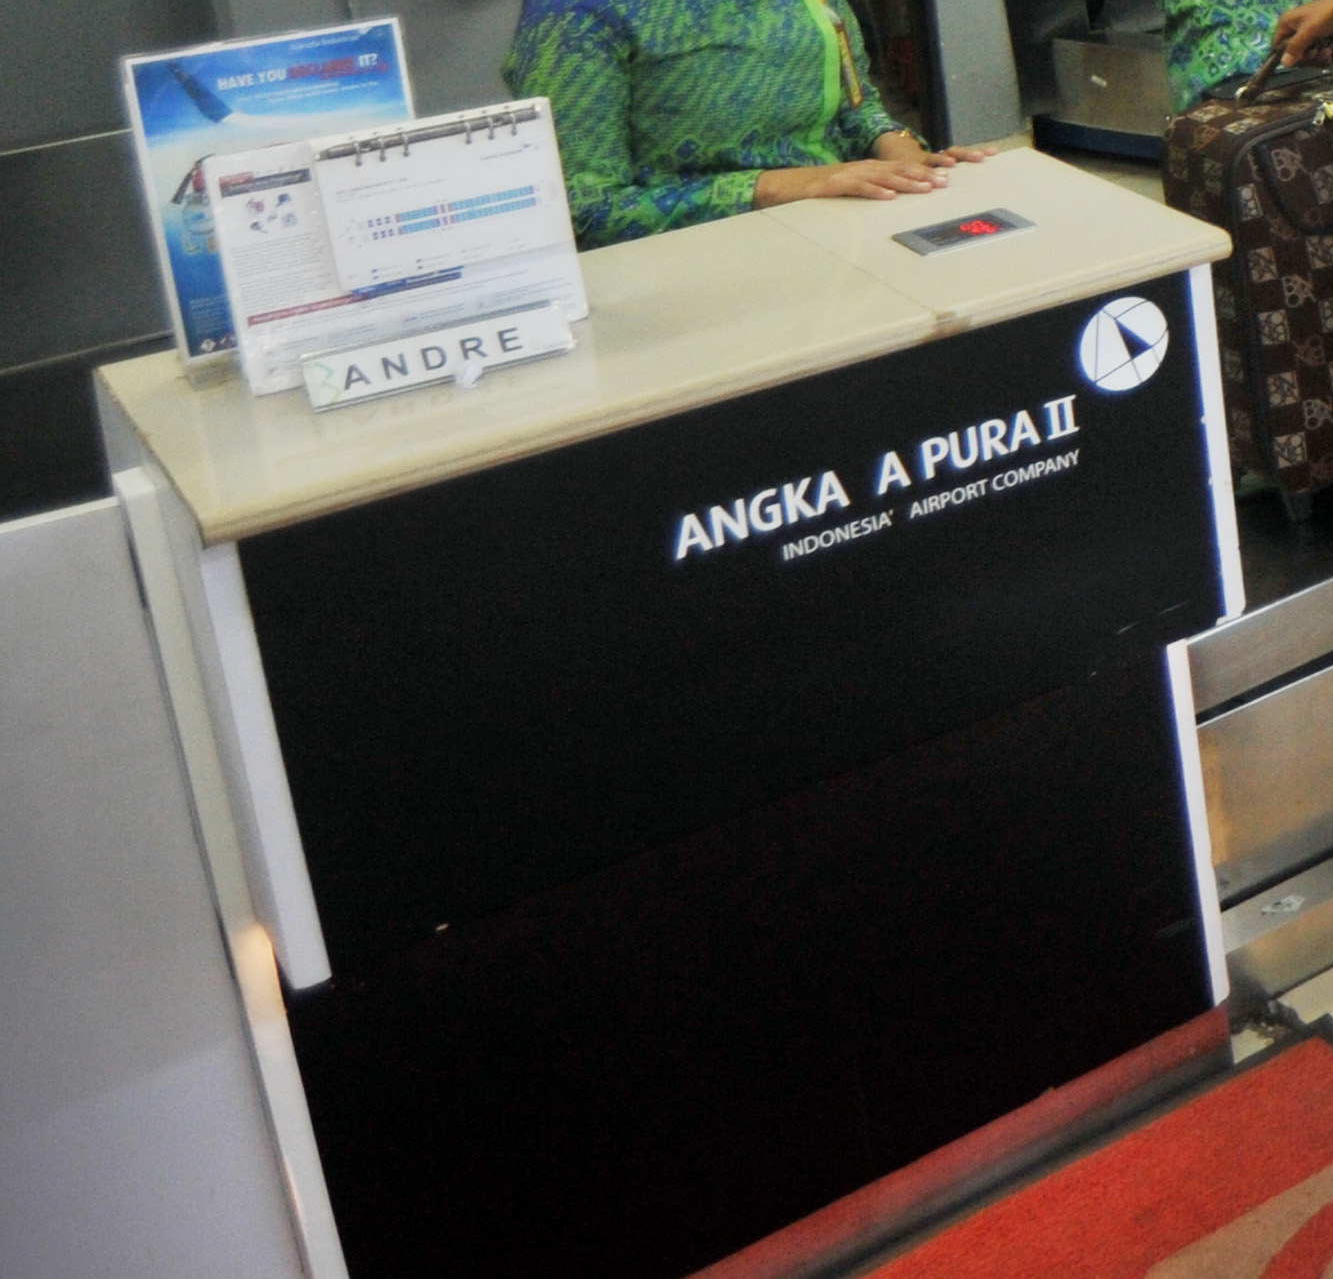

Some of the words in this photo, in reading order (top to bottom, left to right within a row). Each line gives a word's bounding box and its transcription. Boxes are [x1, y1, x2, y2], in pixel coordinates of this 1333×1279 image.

[217, 75, 255, 91] HAVE
[258, 68, 287, 84] YOU
[358, 53, 378, 68] IT?
[344, 326, 524, 391] ANDRE
[674, 470, 852, 560] ANGKA
[876, 450, 912, 495] A
[921, 410, 1042, 481] PURA
[1043, 394, 1081, 442] II
[909, 478, 990, 520] AIRPORT
[990, 448, 1081, 493] COMPANY
